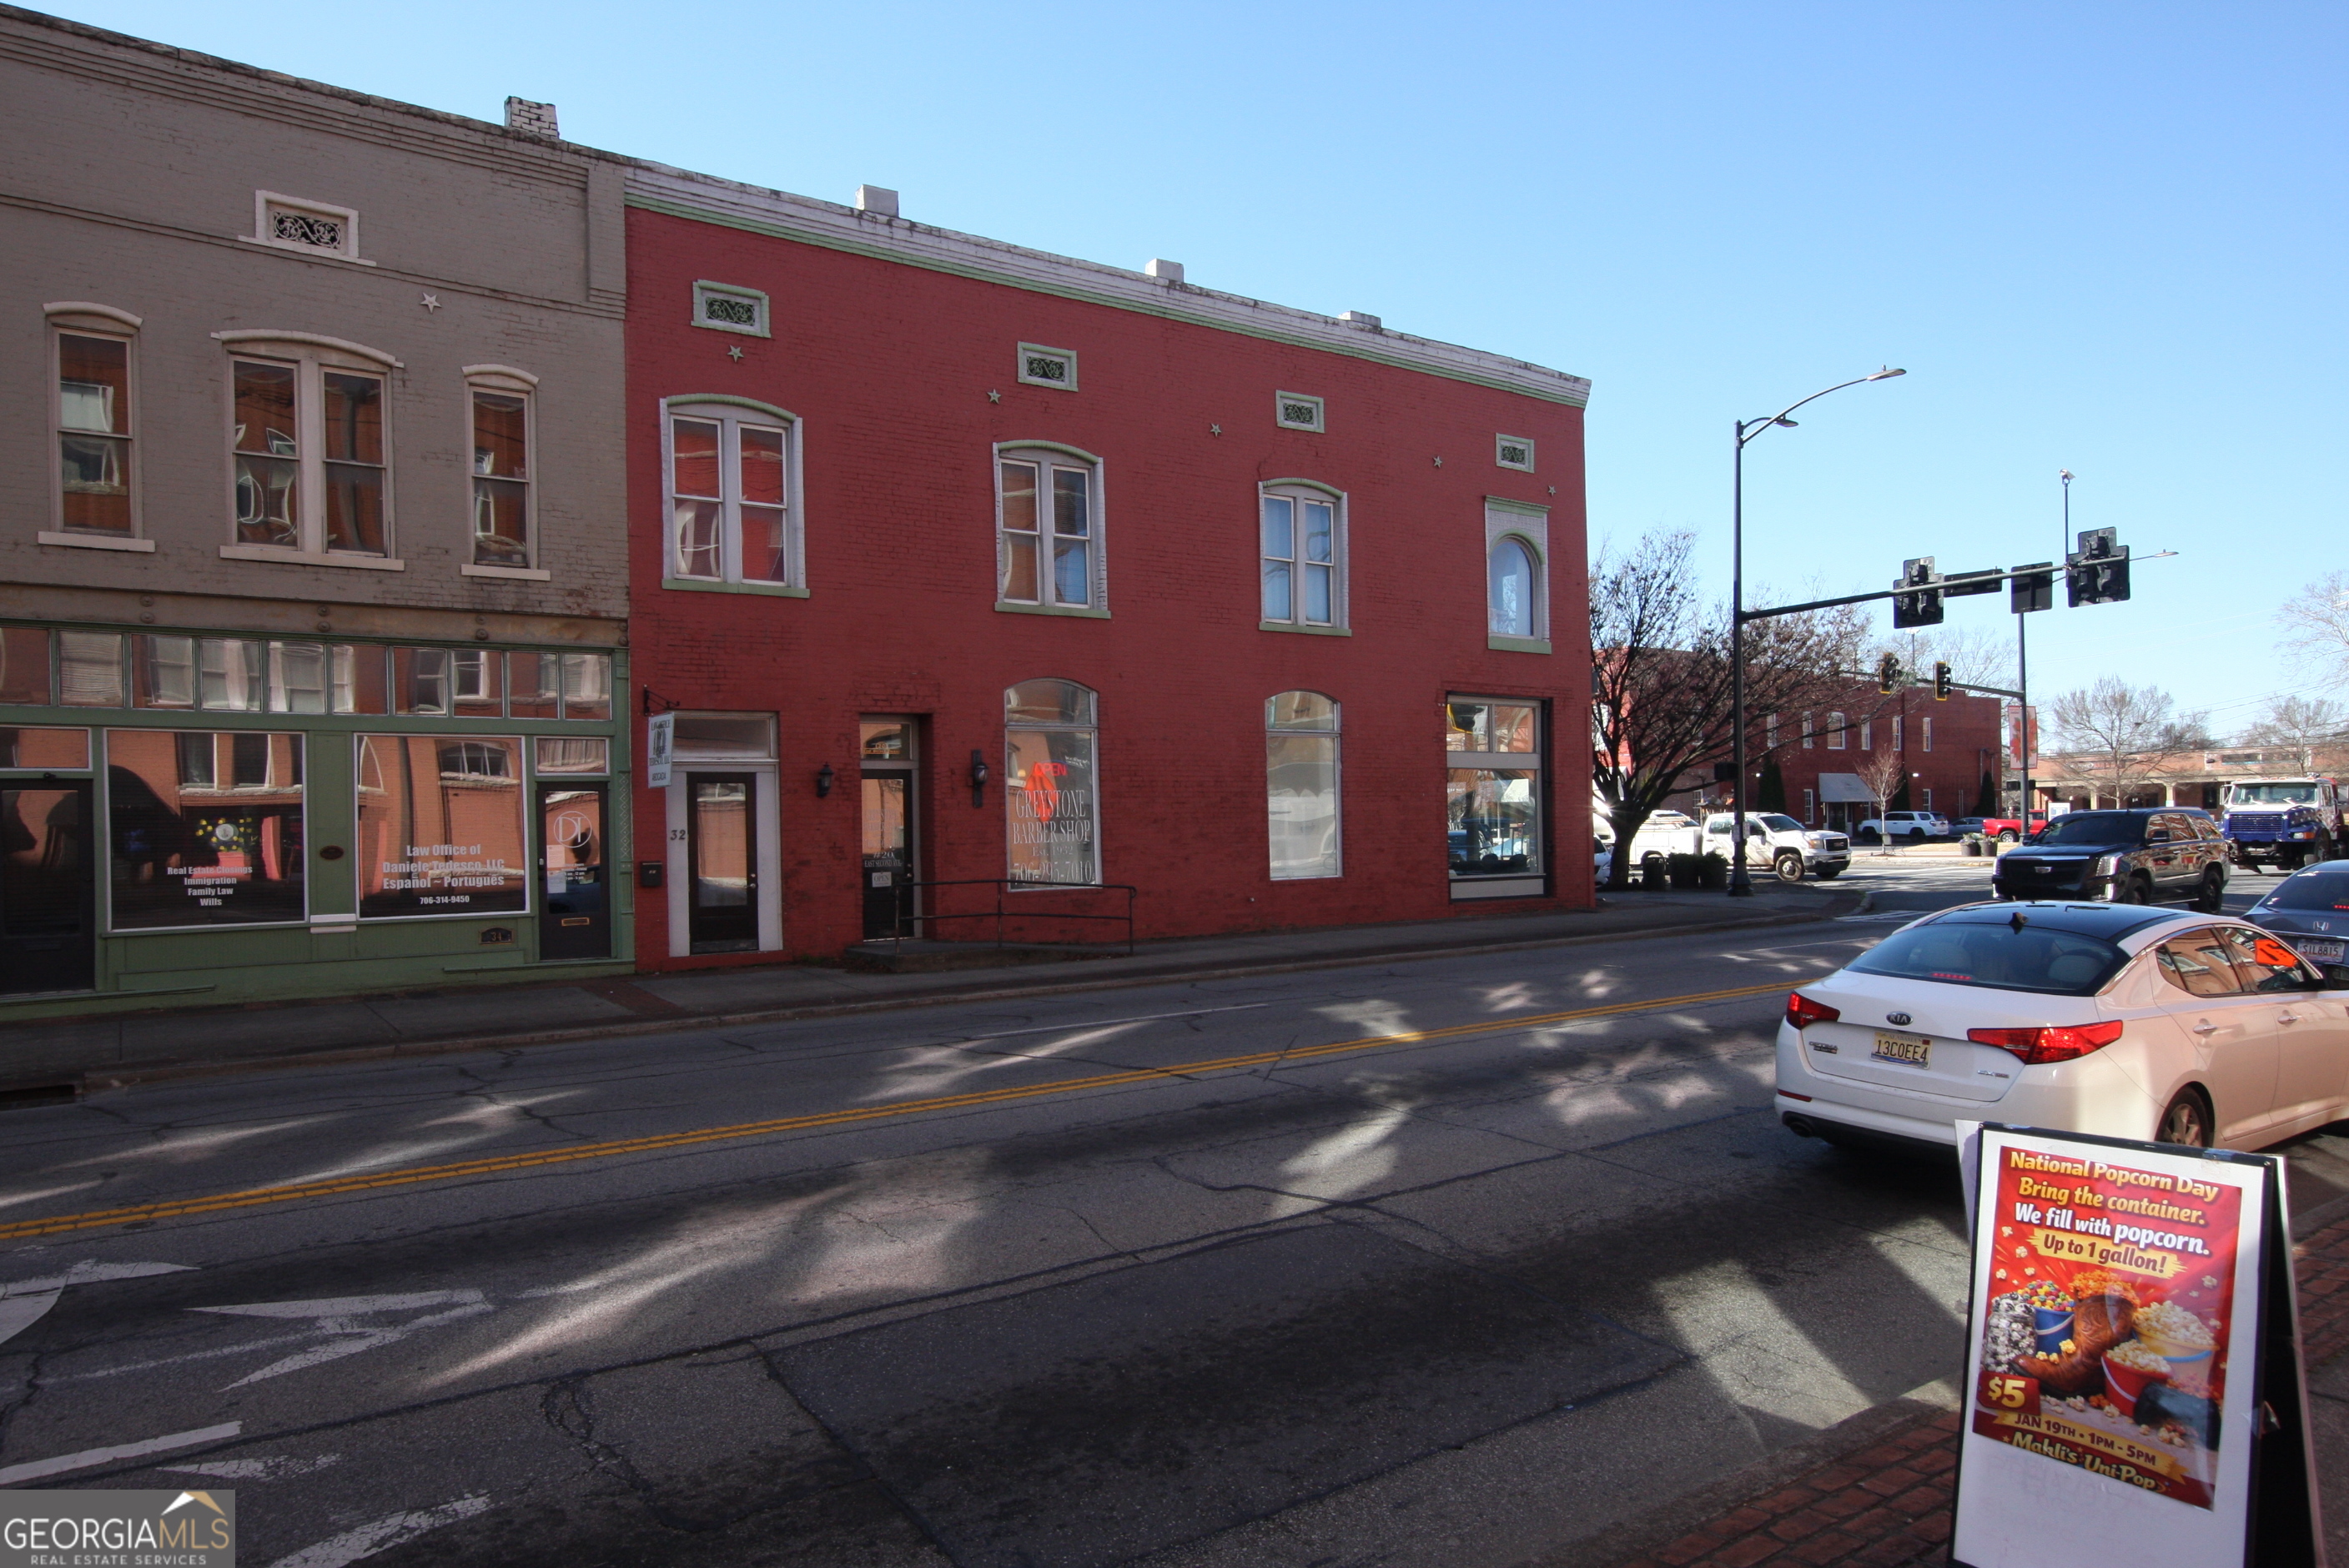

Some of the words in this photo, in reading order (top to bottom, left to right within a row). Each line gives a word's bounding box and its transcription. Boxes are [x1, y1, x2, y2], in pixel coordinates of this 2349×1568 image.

[1034, 762, 1068, 776] OPEN
[1015, 789, 1086, 818] GREYSTONE
[670, 829, 687, 841] 32
[1013, 821, 1058, 844] BARBER
[1060, 819, 1090, 843] SHOP
[406, 845, 430, 857] Law
[432, 844, 467, 856] Office
[470, 844, 481, 855] of
[1032, 847, 1049, 857] Est.
[167, 867, 187, 875] Real
[189, 867, 214, 875] Estate
[217, 866, 253, 874] Closings
[382, 861, 429, 873] Daniele
[486, 859, 506, 870] LLC
[184, 877, 237, 885] Immigration
[383, 875, 431, 891] Español
[188, 887, 215, 896] Family
[217, 887, 234, 895] Law
[200, 897, 223, 906] Wills
[420, 895, 470, 905] 706-314-9450
[1889, 1014, 1909, 1023] KIA
[2010, 1151, 2089, 1178] National
[2093, 1161, 2172, 1190] Popcorn
[2176, 1176, 2219, 1203] Day
[2019, 1177, 2070, 1205] Bring
[2074, 1185, 2104, 1208] the
[2107, 1194, 2206, 1225] container.
[2015, 1202, 2041, 1224] We
[2045, 1207, 2073, 1230] fill
[2075, 1217, 2111, 1237] with
[2114, 1223, 2211, 1255] popcorn.
[2044, 1234, 2064, 1254] Up
[2068, 1239, 2084, 1255] to
[2087, 1241, 2097, 1258] 1
[2099, 1248, 2167, 1274] gallon!
[1988, 1375, 2026, 1409] $5
[2015, 1413, 2041, 1429] JAN
[2045, 1420, 2076, 1438] 19TH
[2088, 1432, 2115, 1450] 1PM
[2126, 1445, 2156, 1466] 5PM
[2011, 1431, 2078, 1465] Mahli's
[2084, 1454, 2155, 1490] Uni-Pop
